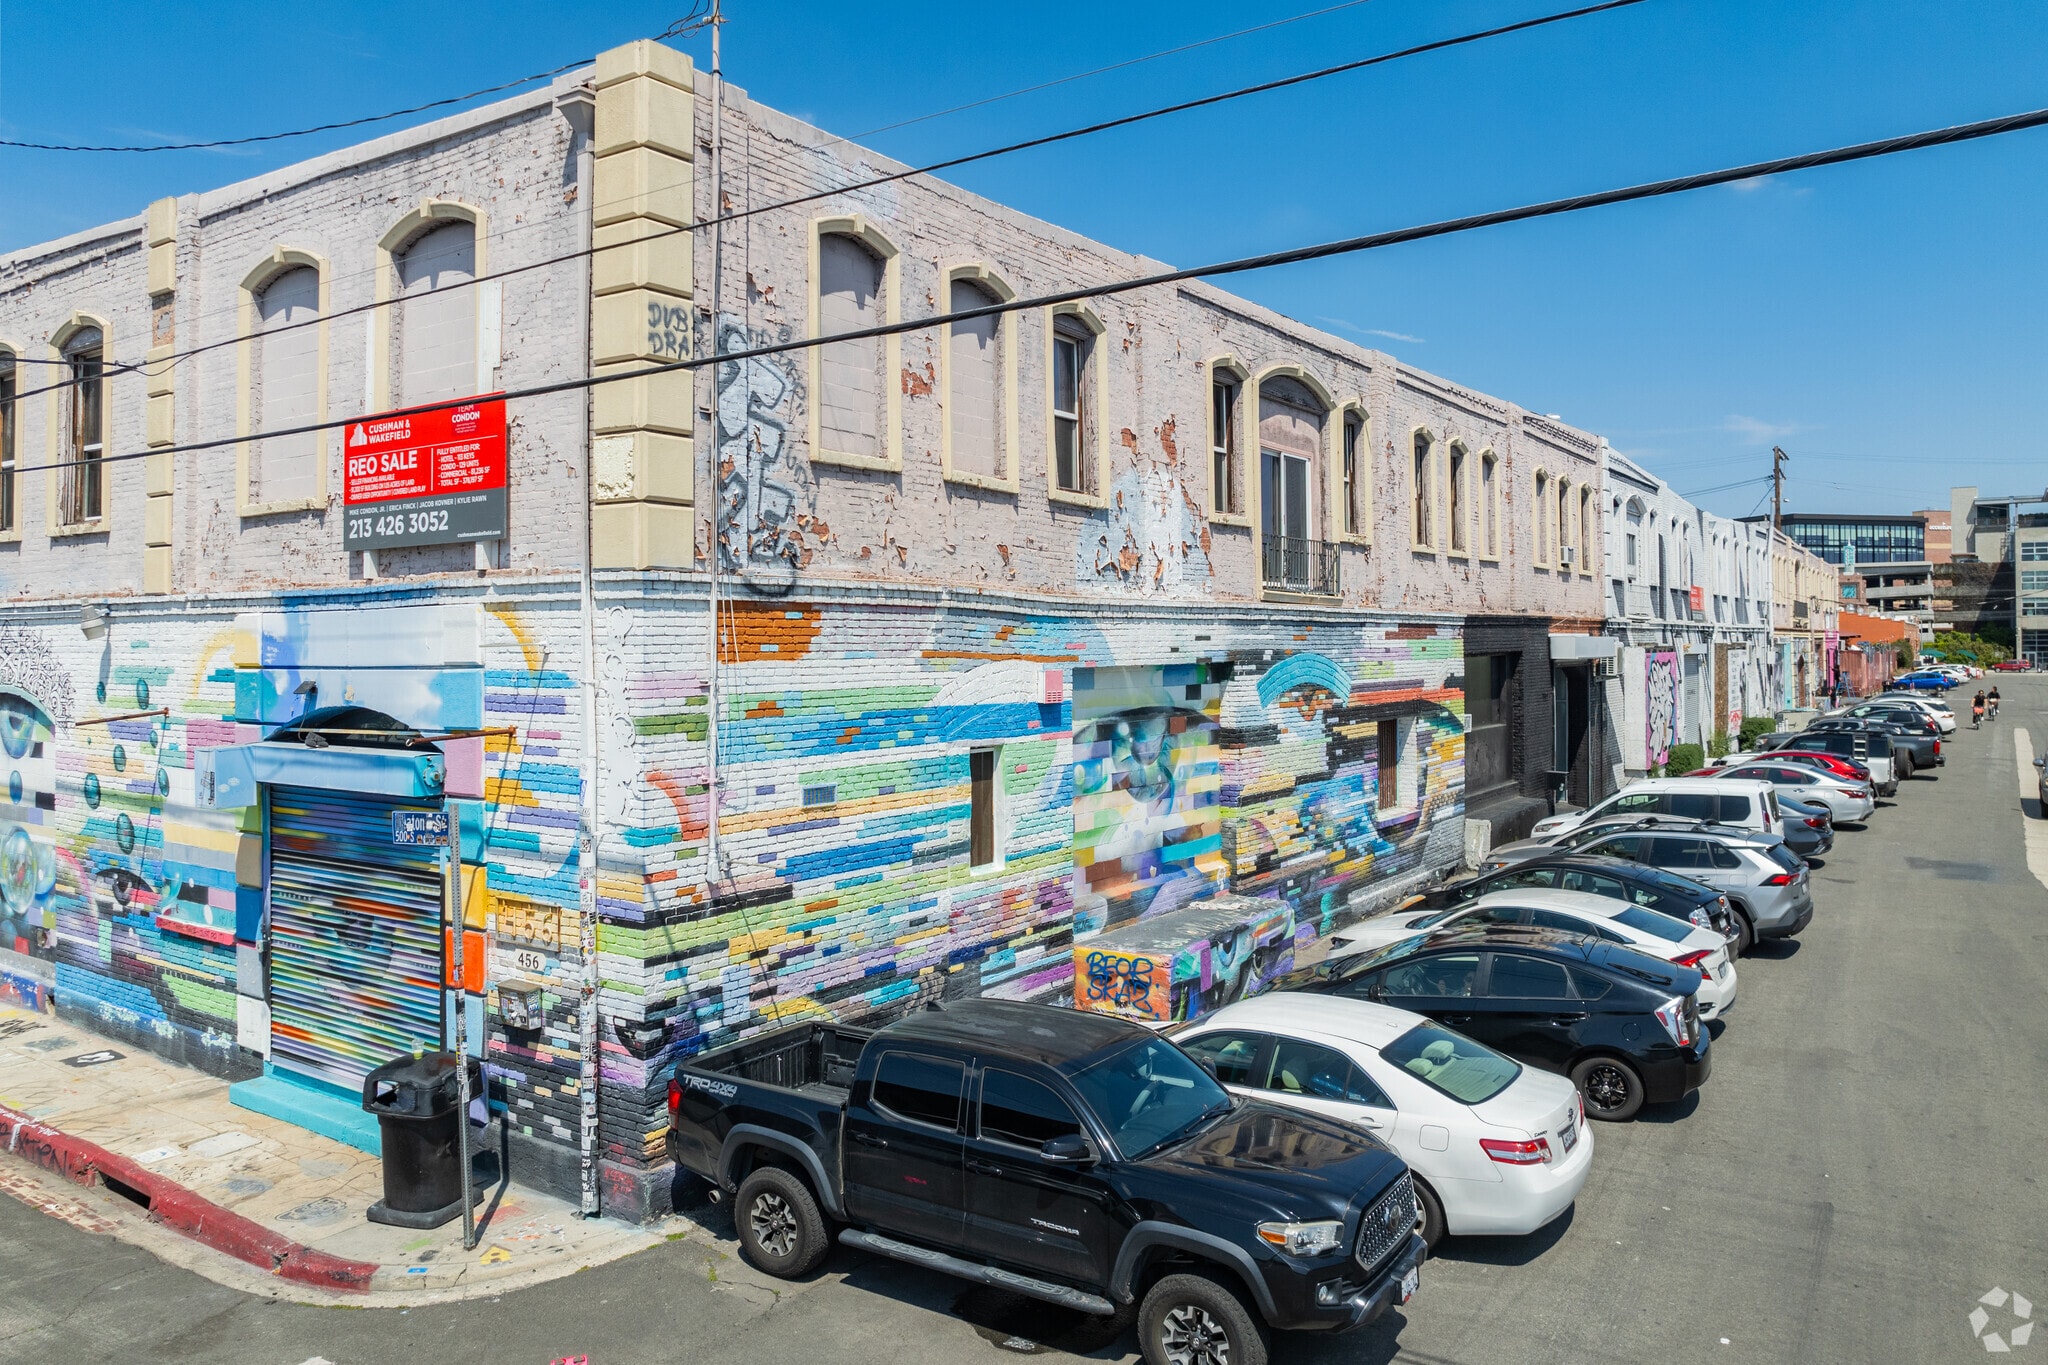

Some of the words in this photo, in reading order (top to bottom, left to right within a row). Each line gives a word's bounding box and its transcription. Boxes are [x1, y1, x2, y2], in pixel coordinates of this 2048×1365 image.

[452, 411, 480, 423] CONDON
[369, 420, 404, 434] CUSHMAN
[405, 419, 410, 428] &
[369, 430, 410, 444] WAKEFIELD
[349, 456, 378, 477] REO
[381, 450, 418, 472] SALE
[435, 499, 453, 507] KOVNER
[349, 518, 372, 539] 213
[376, 514, 404, 536] 426
[408, 510, 448, 534] 3052
[395, 831, 408, 842] 500
[410, 832, 415, 842] S
[518, 952, 540, 970] 456
[683, 1074, 710, 1090] TRD
[1030, 1217, 1080, 1236] TACOMA
